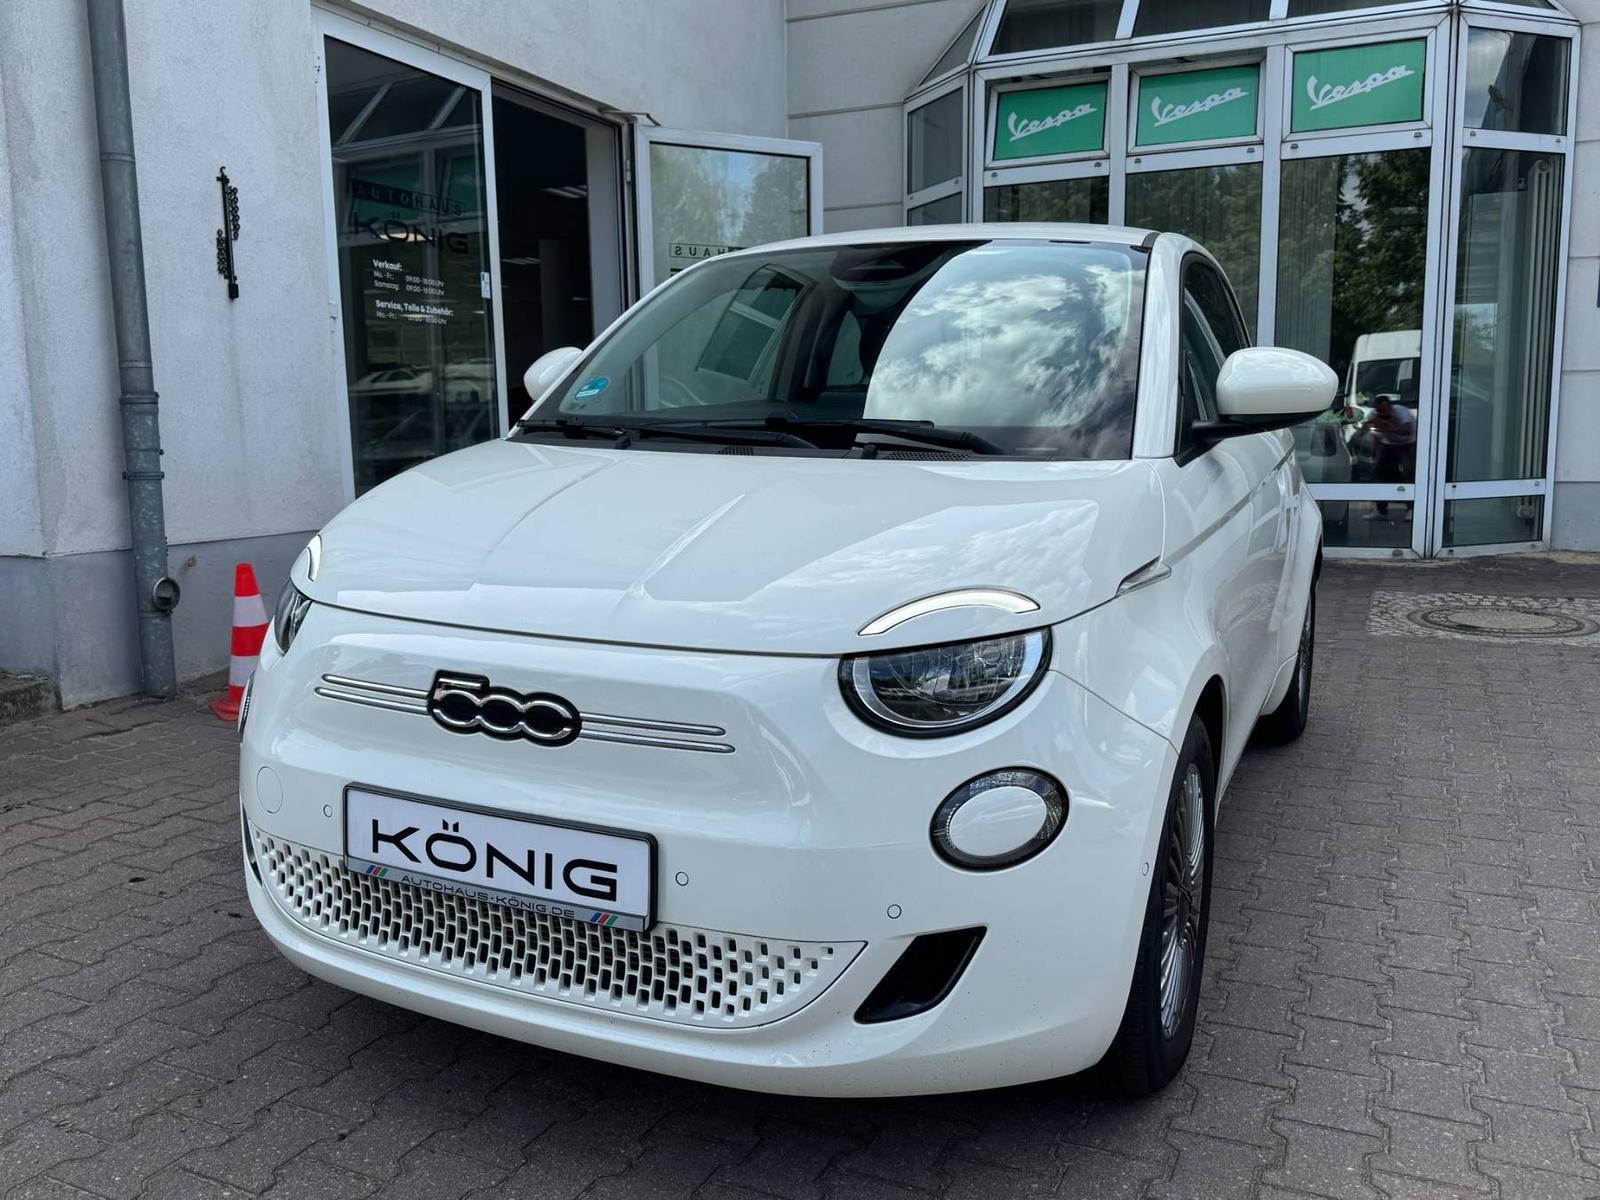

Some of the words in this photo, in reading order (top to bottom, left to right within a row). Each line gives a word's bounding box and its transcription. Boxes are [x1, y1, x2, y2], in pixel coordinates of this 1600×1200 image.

[1151, 87, 1250, 128] Vespa
[1306, 64, 1416, 111] Vespa
[1008, 102, 1098, 142] Vespa
[357, 183, 462, 216] AUTOHAUS
[354, 211, 468, 253] KÖNIG
[372, 259, 402, 271] Verkauf:
[375, 299, 403, 312] Service,
[428, 669, 582, 747] 500
[371, 818, 618, 902] KÖNIG
